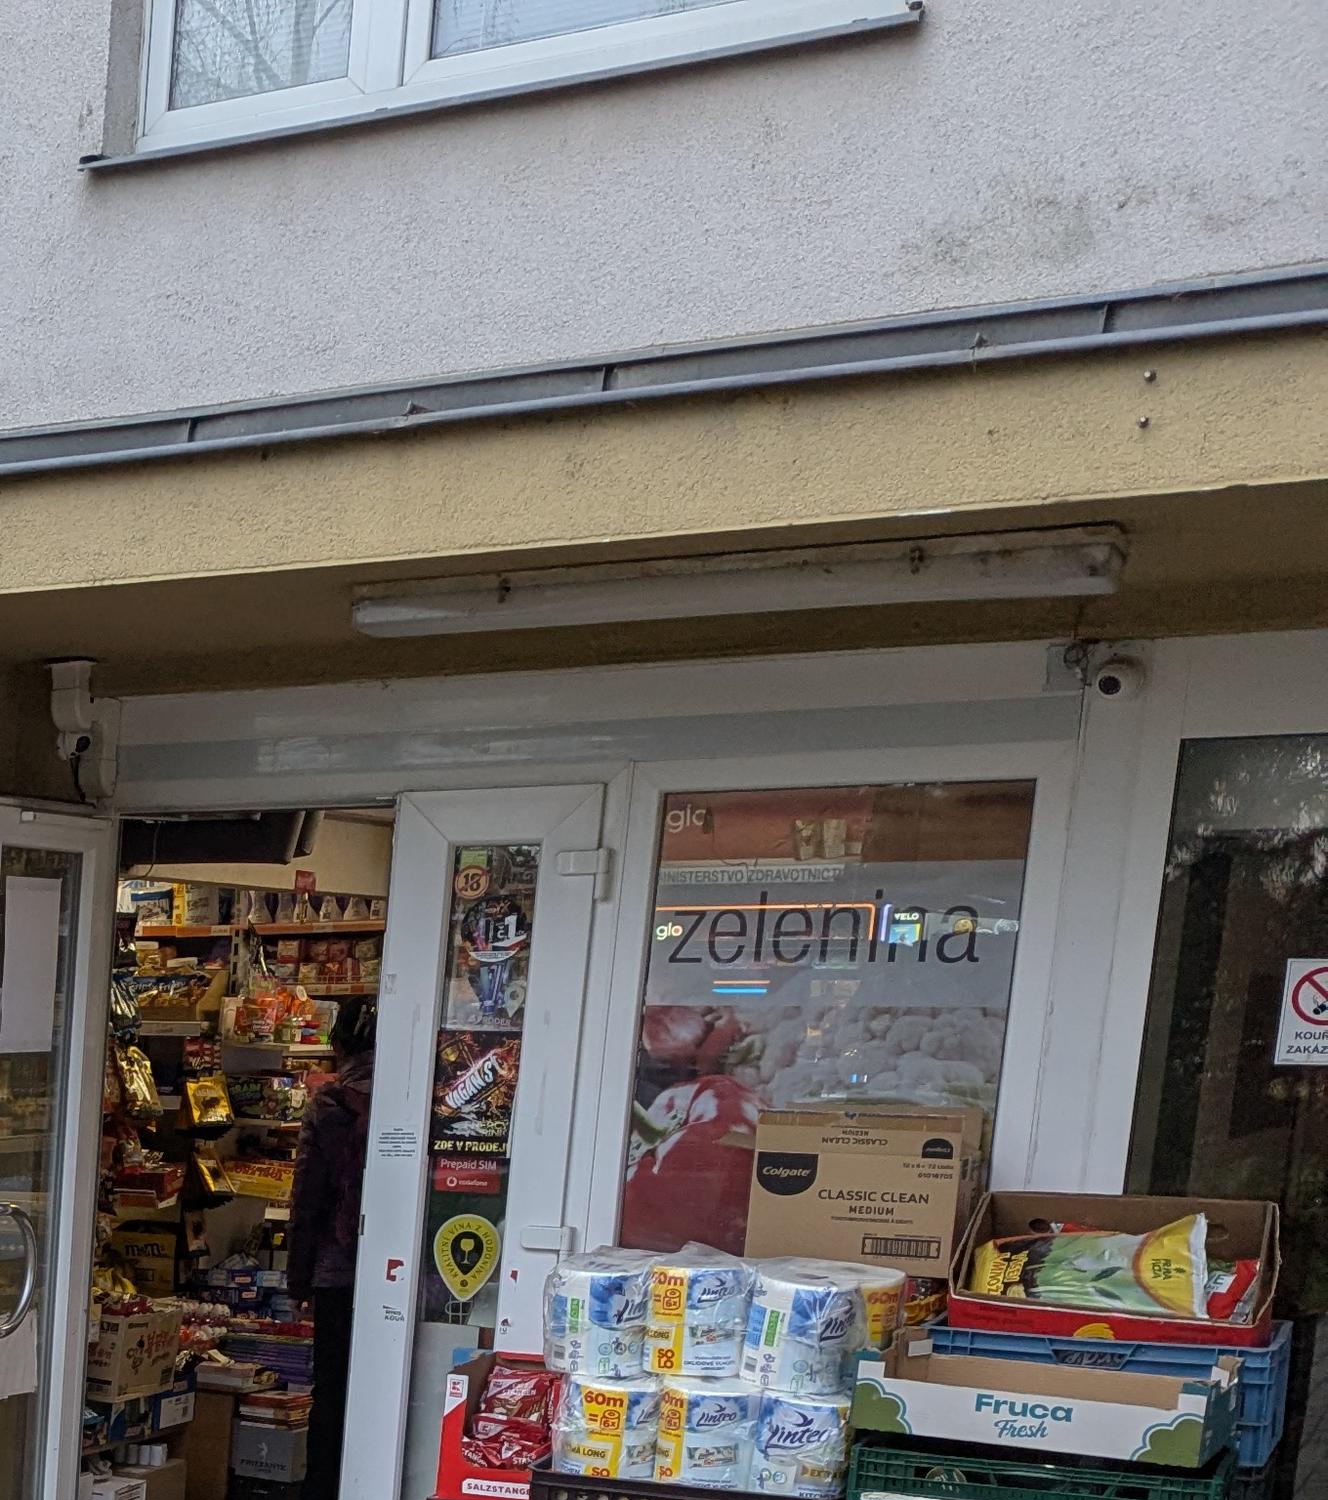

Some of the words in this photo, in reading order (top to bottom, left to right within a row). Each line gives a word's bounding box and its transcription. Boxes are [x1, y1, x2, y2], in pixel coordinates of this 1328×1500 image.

[659, 868, 745, 883] INISTERSTVO
[894, 911, 920, 921] VELO
[668, 888, 981, 964] zelenina
[434, 1141, 454, 1151] ZDE
[456, 1142, 464, 1151] V
[440, 1159, 477, 1170] Prepaid
[479, 1160, 497, 1171] SIM
[762, 1166, 811, 1178] Colgate
[818, 1189, 878, 1202] CLASSIC
[881, 1192, 929, 1204] CLEAN
[848, 1205, 894, 1216] MEDIUM
[657, 1348, 675, 1358] SO
[658, 1359, 674, 1369] LO
[584, 1391, 625, 1408] 60m
[663, 1390, 684, 1408] 0m
[975, 1393, 1074, 1423] Fruca
[603, 1419, 617, 1428] 6x
[993, 1419, 1048, 1438] Fresh
[583, 1447, 606, 1459] LONG
[467, 1481, 530, 1496] SALZSTANGE
